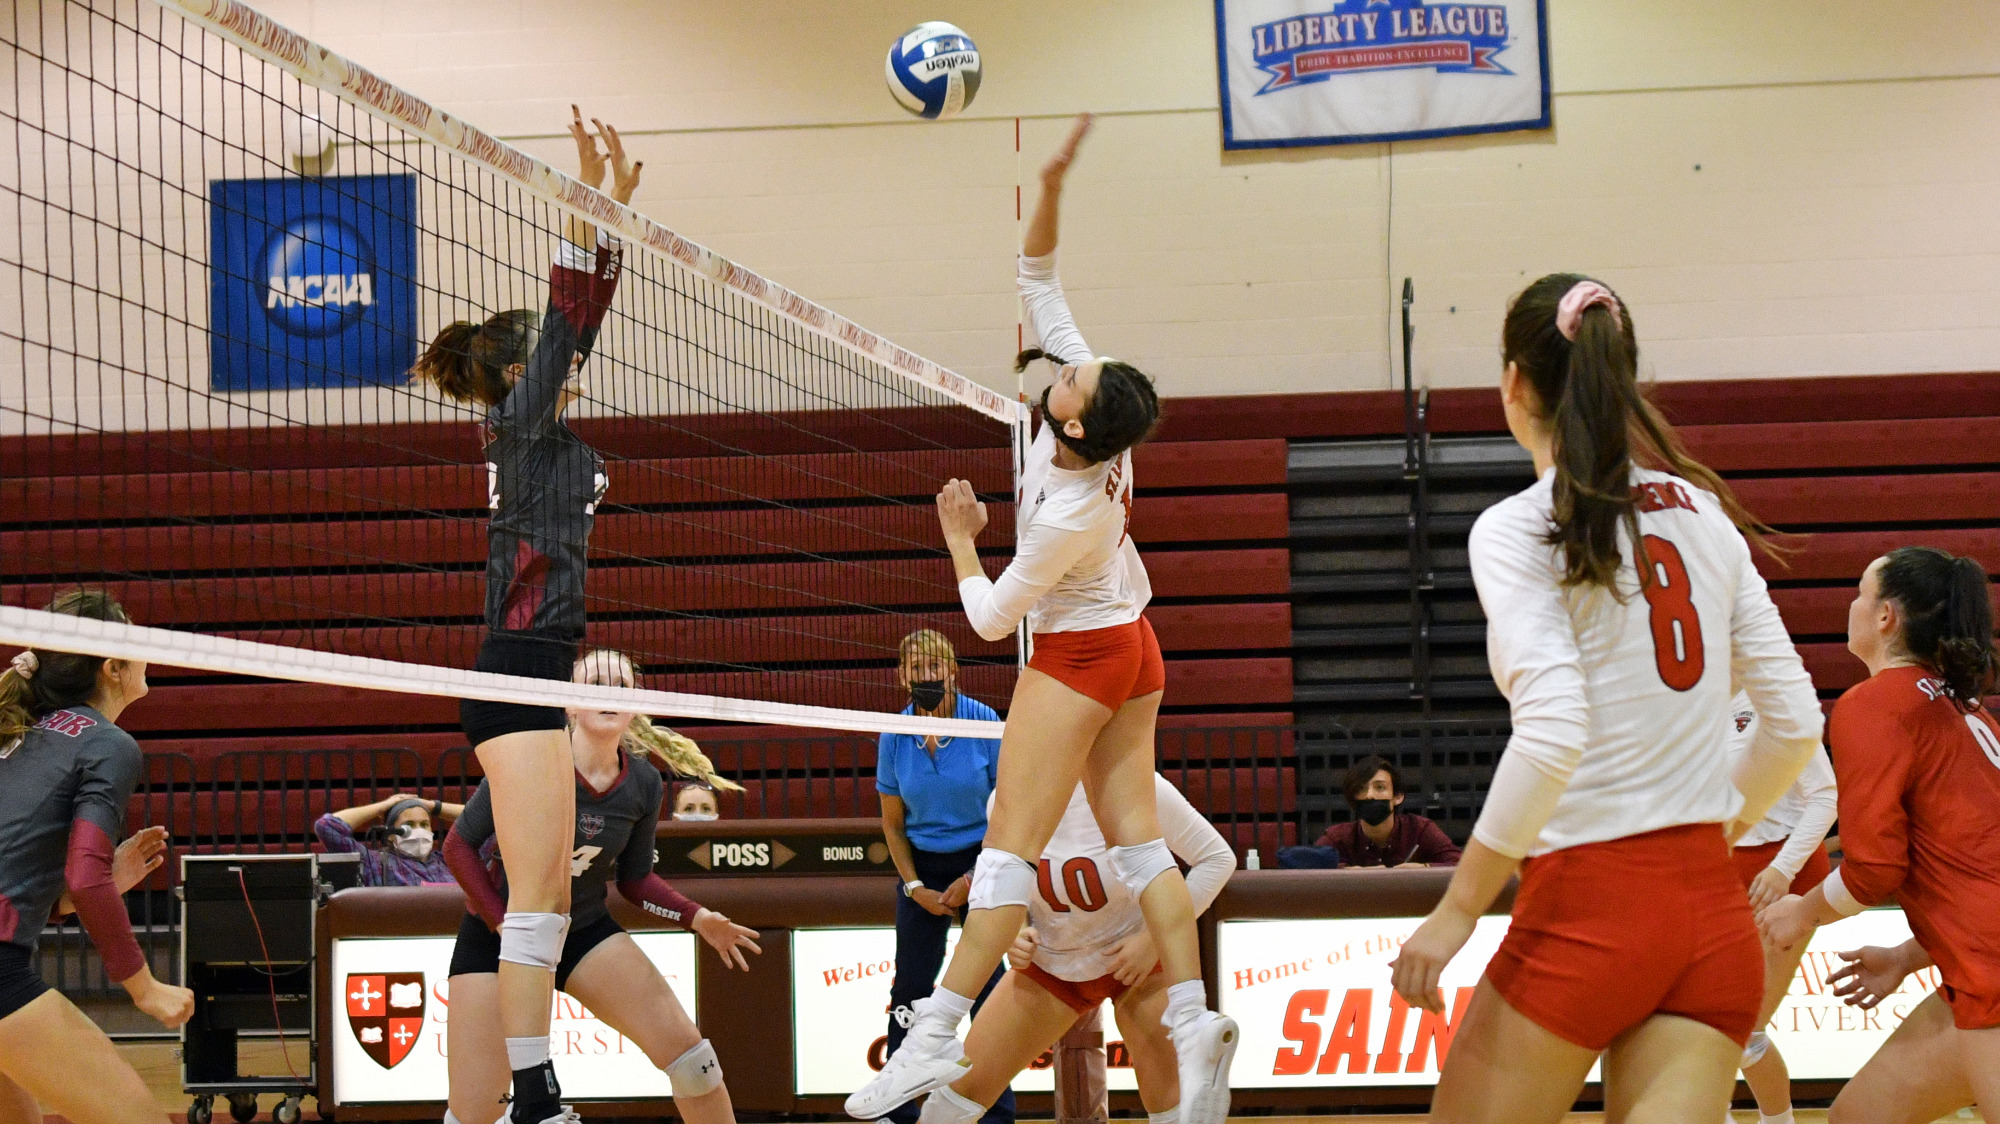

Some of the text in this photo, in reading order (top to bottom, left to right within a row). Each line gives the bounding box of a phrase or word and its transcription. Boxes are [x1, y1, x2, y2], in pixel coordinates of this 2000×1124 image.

[1255, 6, 1507, 57] LIBERTY LEAGUE
[926, 53, 974, 72] molten
[603, 251, 620, 280] VAS
[267, 273, 373, 309] NCAA
[1633, 534, 1705, 692] 8
[712, 843, 770, 867] POSS
[823, 846, 865, 862] BONUS
[1036, 856, 1109, 913] 10
[823, 960, 897, 987] Welco
[1233, 933, 1408, 991] Home of the
[1272, 986, 1475, 1076] SAIN
